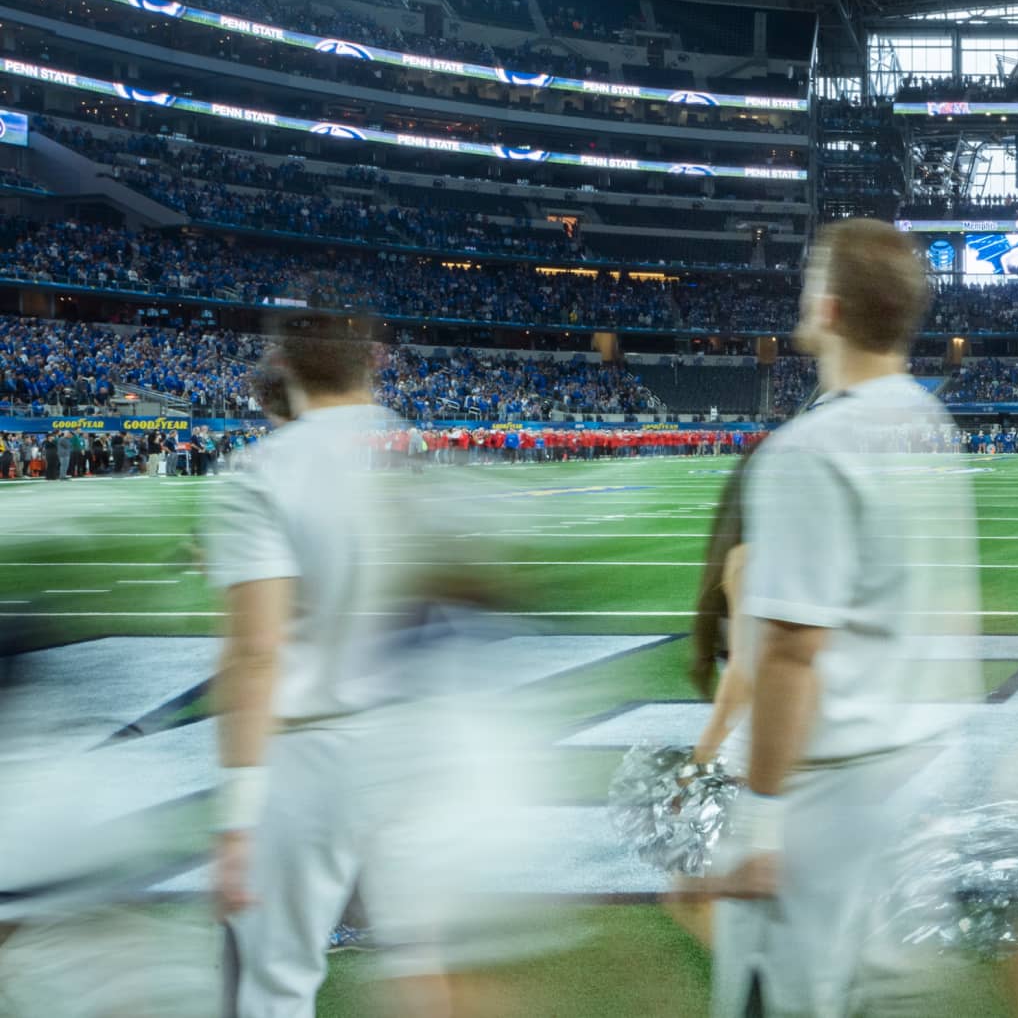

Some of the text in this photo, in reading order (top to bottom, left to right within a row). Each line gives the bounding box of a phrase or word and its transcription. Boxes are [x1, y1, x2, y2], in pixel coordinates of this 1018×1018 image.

[220, 15, 284, 39] PENN STATE
[402, 54, 464, 73] PENN STATE
[4, 59, 77, 85] PENN STATE
[584, 82, 640, 96] PENN STATE
[745, 97, 799, 109] PENN STATE
[212, 104, 277, 124] PENN STATE
[398, 134, 460, 151] PENN STATE
[581, 155, 639, 169] PENN STATE
[745, 167, 799, 179] PENN STATE
[962, 221, 998, 231] Memphis
[52, 419, 104, 429] GOODYEAR
[123, 418, 187, 430] GOODYEAR
